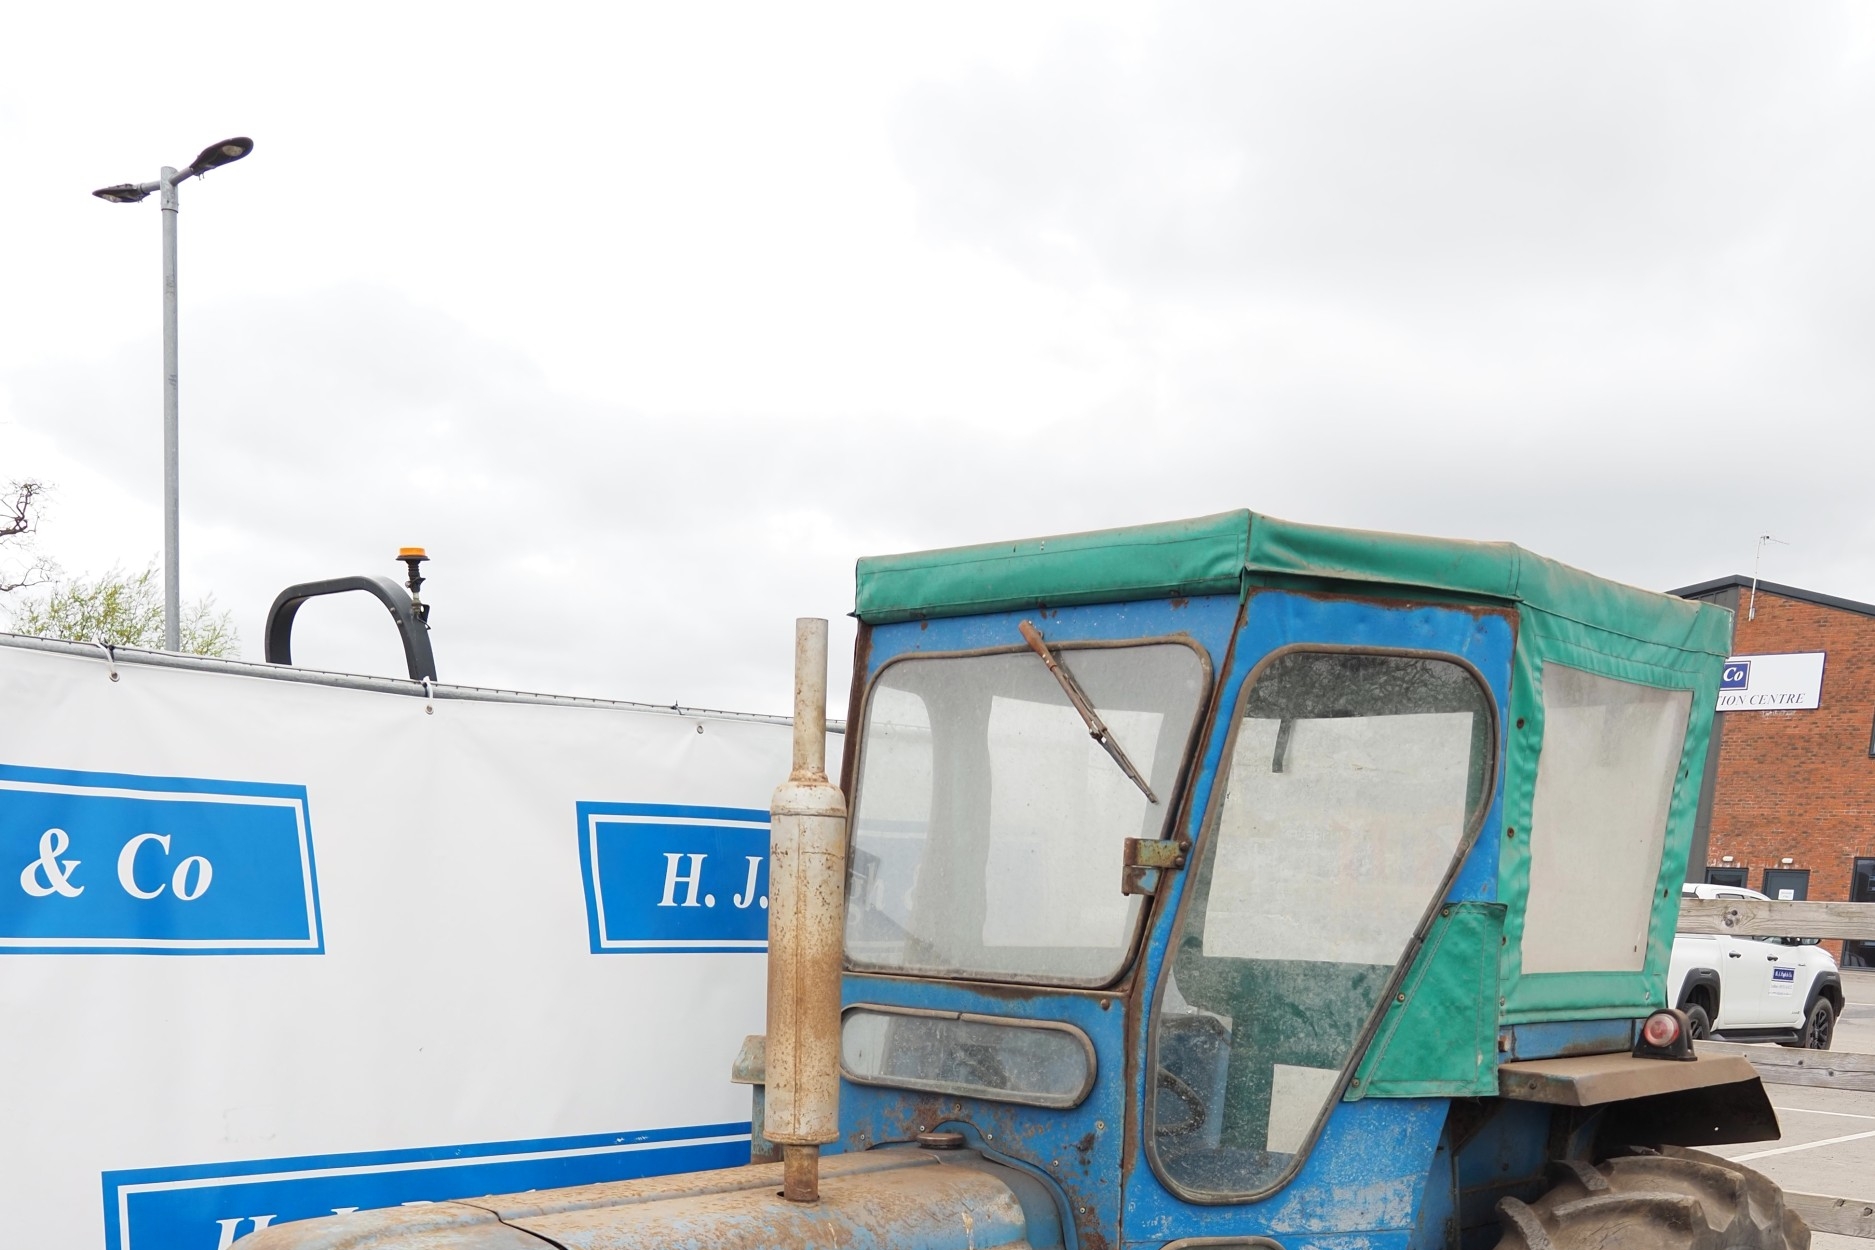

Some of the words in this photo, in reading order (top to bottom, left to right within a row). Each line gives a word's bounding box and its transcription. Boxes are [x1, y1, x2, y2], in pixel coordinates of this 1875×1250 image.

[1723, 667, 1744, 682] Co
[1749, 693, 1806, 706] CENTRE
[20, 828, 85, 898] &
[117, 833, 213, 901] Co
[657, 852, 716, 908] H.
[733, 855, 769, 910] J.
